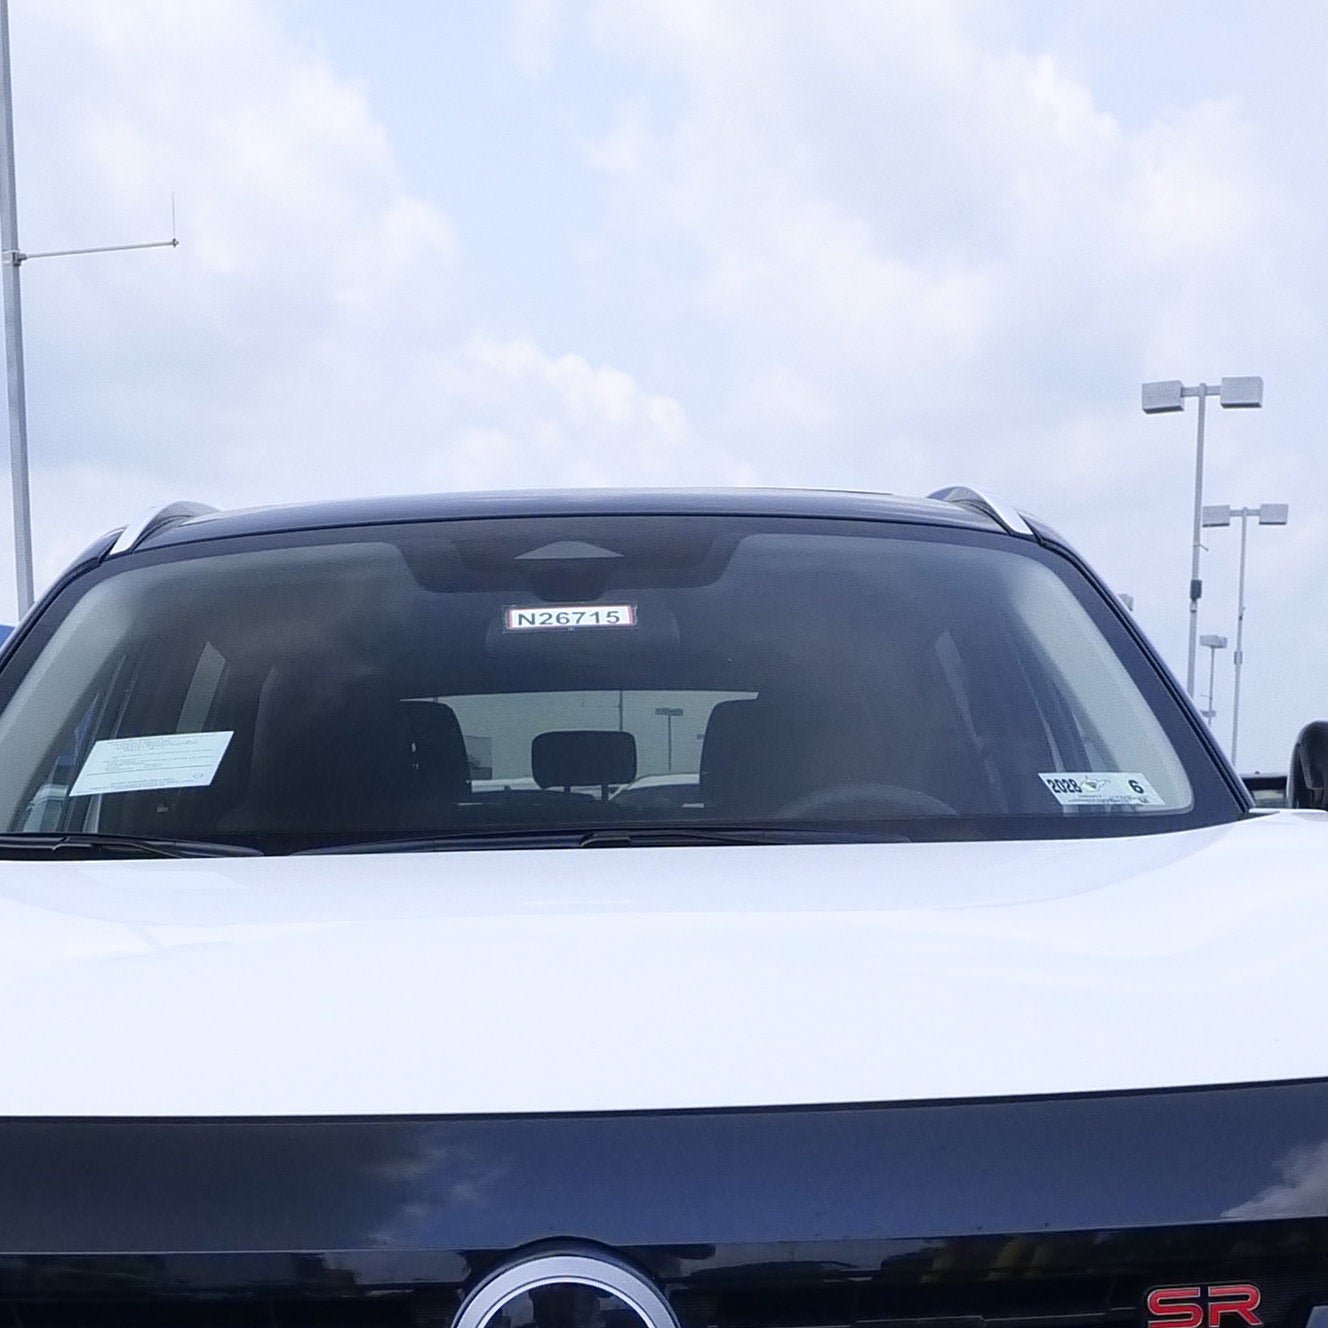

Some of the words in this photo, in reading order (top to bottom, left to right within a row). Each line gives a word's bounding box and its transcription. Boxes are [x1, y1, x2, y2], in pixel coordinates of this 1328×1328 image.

[517, 610, 621, 626] N26715
[1046, 778, 1083, 794] 2028
[1128, 779, 1145, 794] 6
